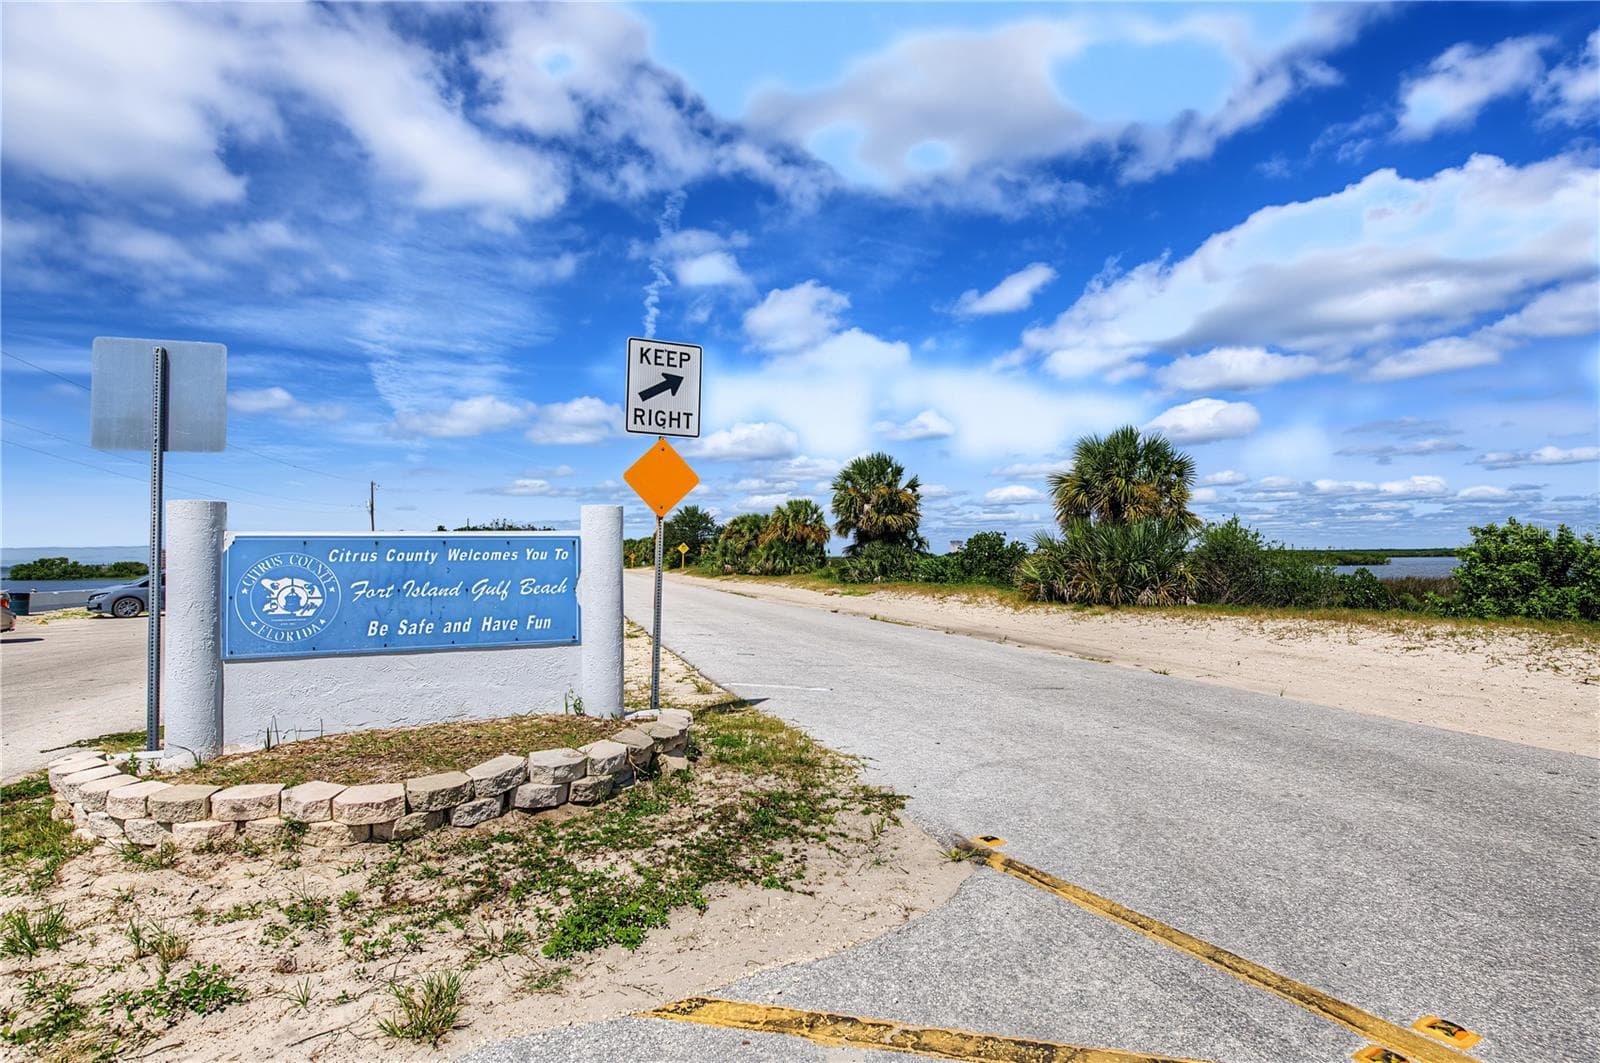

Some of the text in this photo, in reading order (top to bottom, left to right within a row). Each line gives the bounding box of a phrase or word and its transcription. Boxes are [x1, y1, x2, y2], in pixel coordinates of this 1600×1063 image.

[640, 347, 691, 369] KEEP
[633, 408, 693, 430] RIGHT
[328, 548, 569, 565] Citrus County Welcomes You To
[242, 554, 336, 586] CITRUS COUNTY
[350, 577, 568, 603] Fort Island Gulf Beach
[257, 623, 321, 642] FLORIDA
[367, 615, 552, 637] Be Safe and Have Fun
